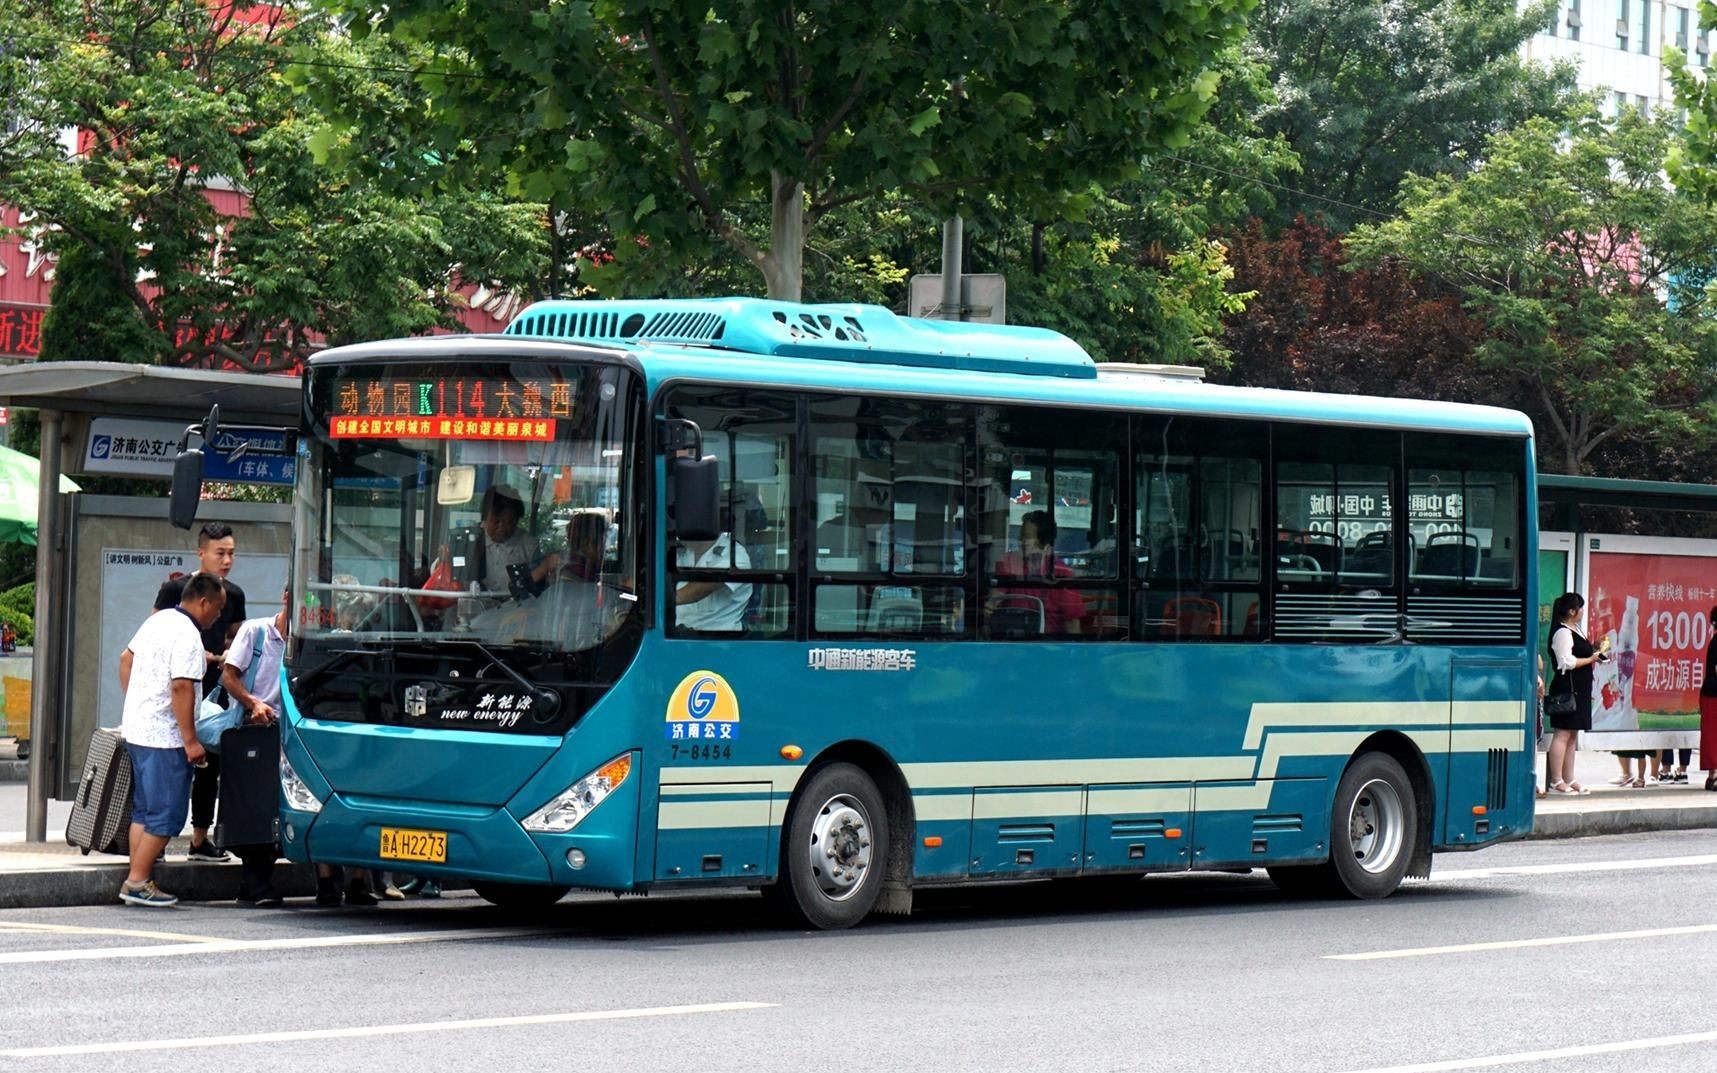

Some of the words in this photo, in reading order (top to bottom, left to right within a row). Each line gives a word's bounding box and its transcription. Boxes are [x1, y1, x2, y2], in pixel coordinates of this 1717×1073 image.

[340, 381, 411, 417] 动物园
[419, 379, 485, 417] K114
[336, 420, 431, 435] 创建全国文明城市
[440, 421, 547, 437] 建设和谐美丽泉城
[1648, 582, 1684, 602] 营养快线
[1647, 610, 1714, 650] 1300
[808, 647, 916, 671] 中通新能源客车
[1645, 658, 1704, 691] 成功源自
[476, 693, 533, 711] 新能源
[440, 708, 471, 720] new
[473, 709, 524, 727] energy
[672, 723, 732, 739] 济南公交
[671, 744, 731, 760] 7-8454
